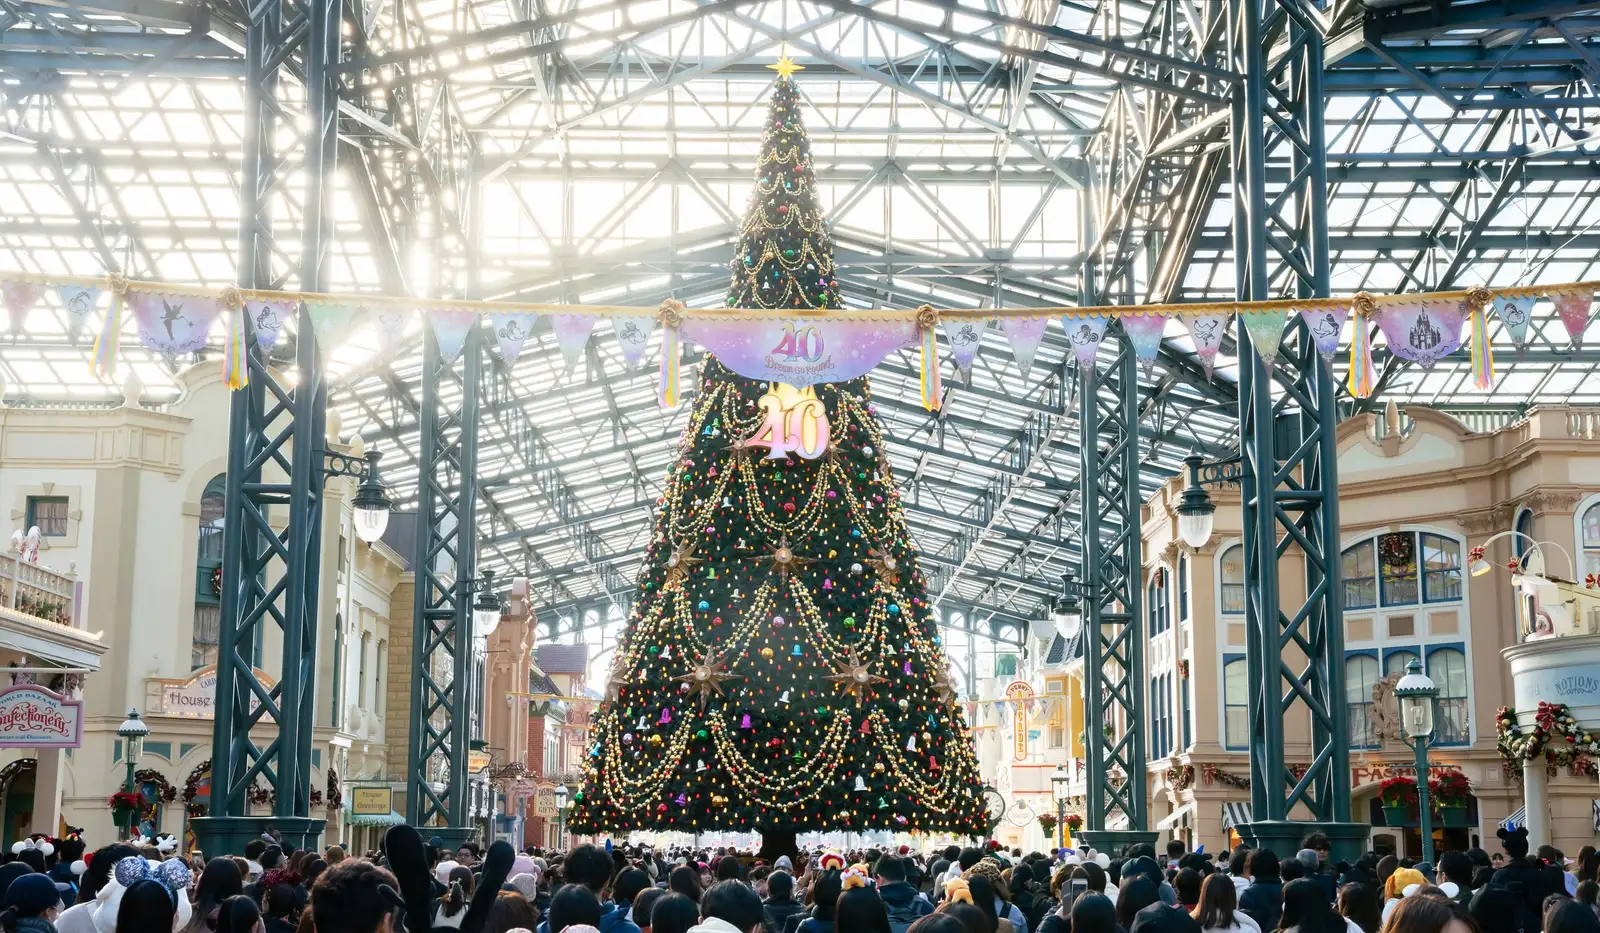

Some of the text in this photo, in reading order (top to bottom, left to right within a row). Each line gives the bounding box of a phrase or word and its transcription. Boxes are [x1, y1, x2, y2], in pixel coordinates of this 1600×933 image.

[771, 321, 825, 363] 40
[764, 355, 794, 374] Dream
[744, 394, 831, 460] 40
[1010, 684, 1030, 692] PENNY
[1554, 675, 1599, 694] NOTIONS
[0, 693, 57, 708] ORLD BAZAAR
[169, 691, 211, 708] House
[0, 702, 70, 737] nfectionery
